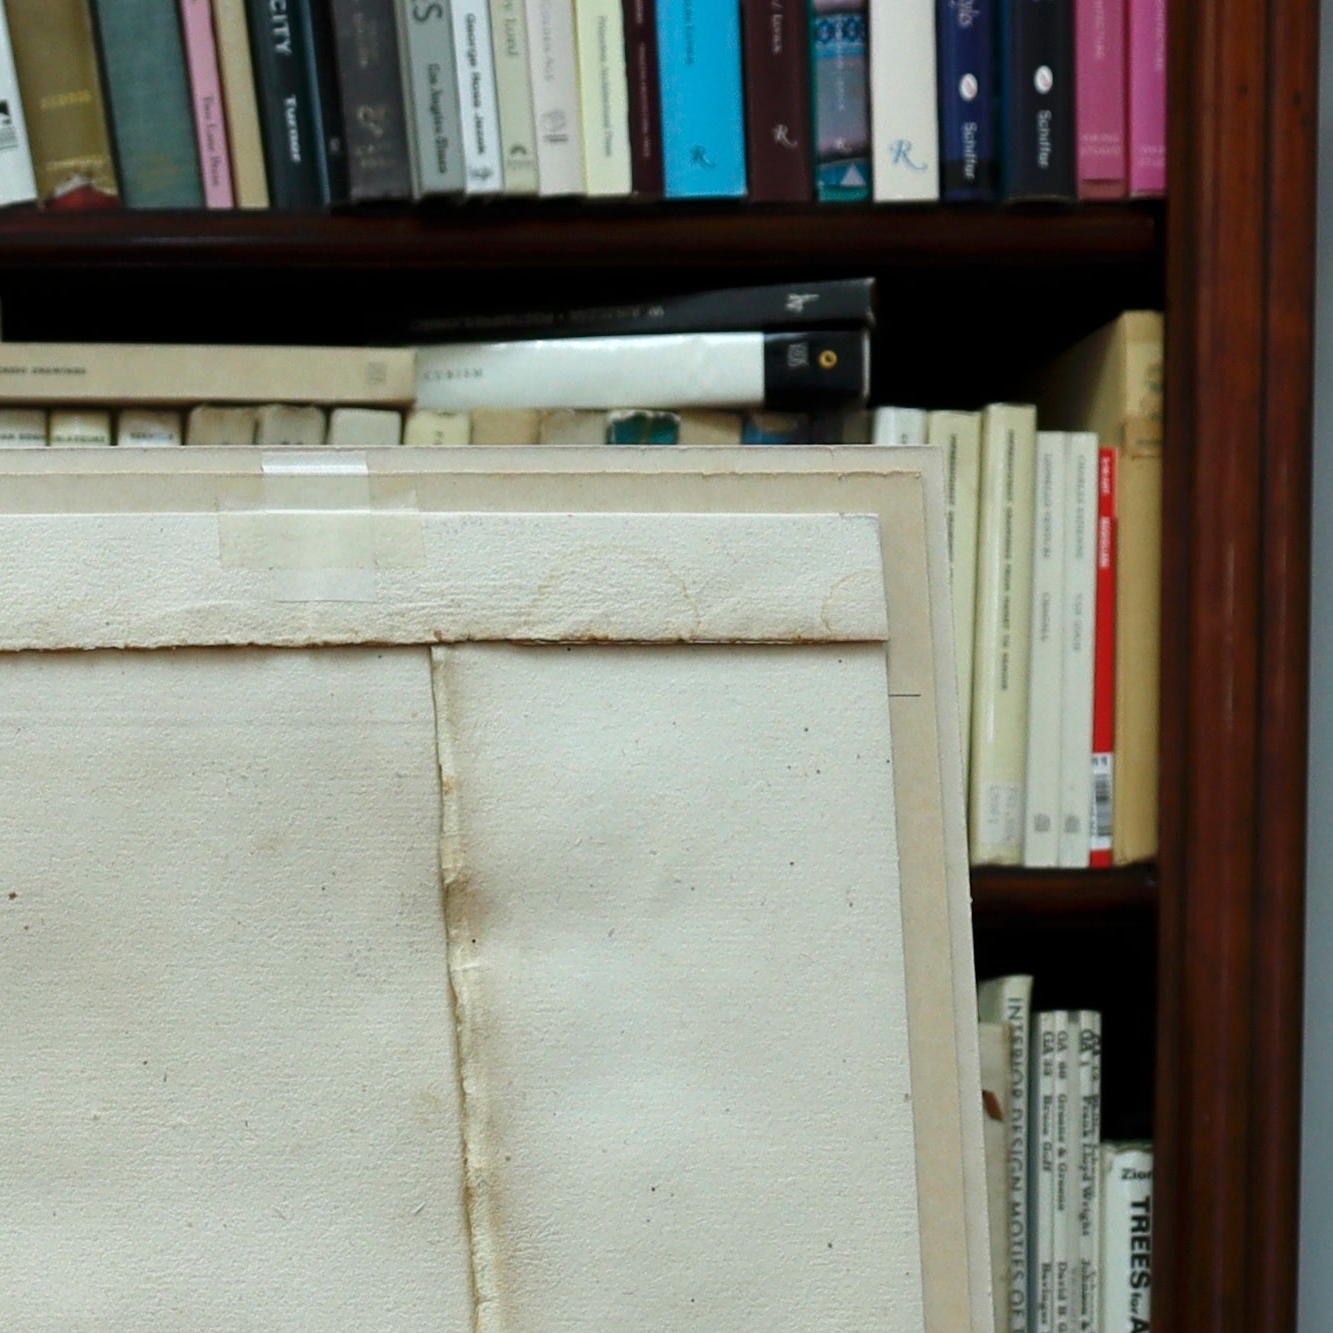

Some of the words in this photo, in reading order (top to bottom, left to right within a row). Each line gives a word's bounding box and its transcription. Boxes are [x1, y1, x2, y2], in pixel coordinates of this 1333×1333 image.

[464, 13, 481, 68] George
[268, 0, 293, 55] CITY
[283, 95, 302, 163] Turner
[962, 121, 978, 181] Schiffer
[1036, 109, 1052, 168] Schiffer
[1008, 997, 1024, 1098] INTERIOR
[1042, 1030, 1056, 1055] GA
[1057, 1029, 1069, 1053] GA
[1009, 1107, 1024, 1192] DESIGN
[1041, 1141, 1054, 1173] Goff
[1010, 1201, 1026, 1283] MOTIFS
[1129, 1196, 1152, 1289] TREES
[1011, 1289, 1026, 1316] OF
[1057, 1261, 1069, 1301] David
[1129, 1292, 1144, 1315] for
